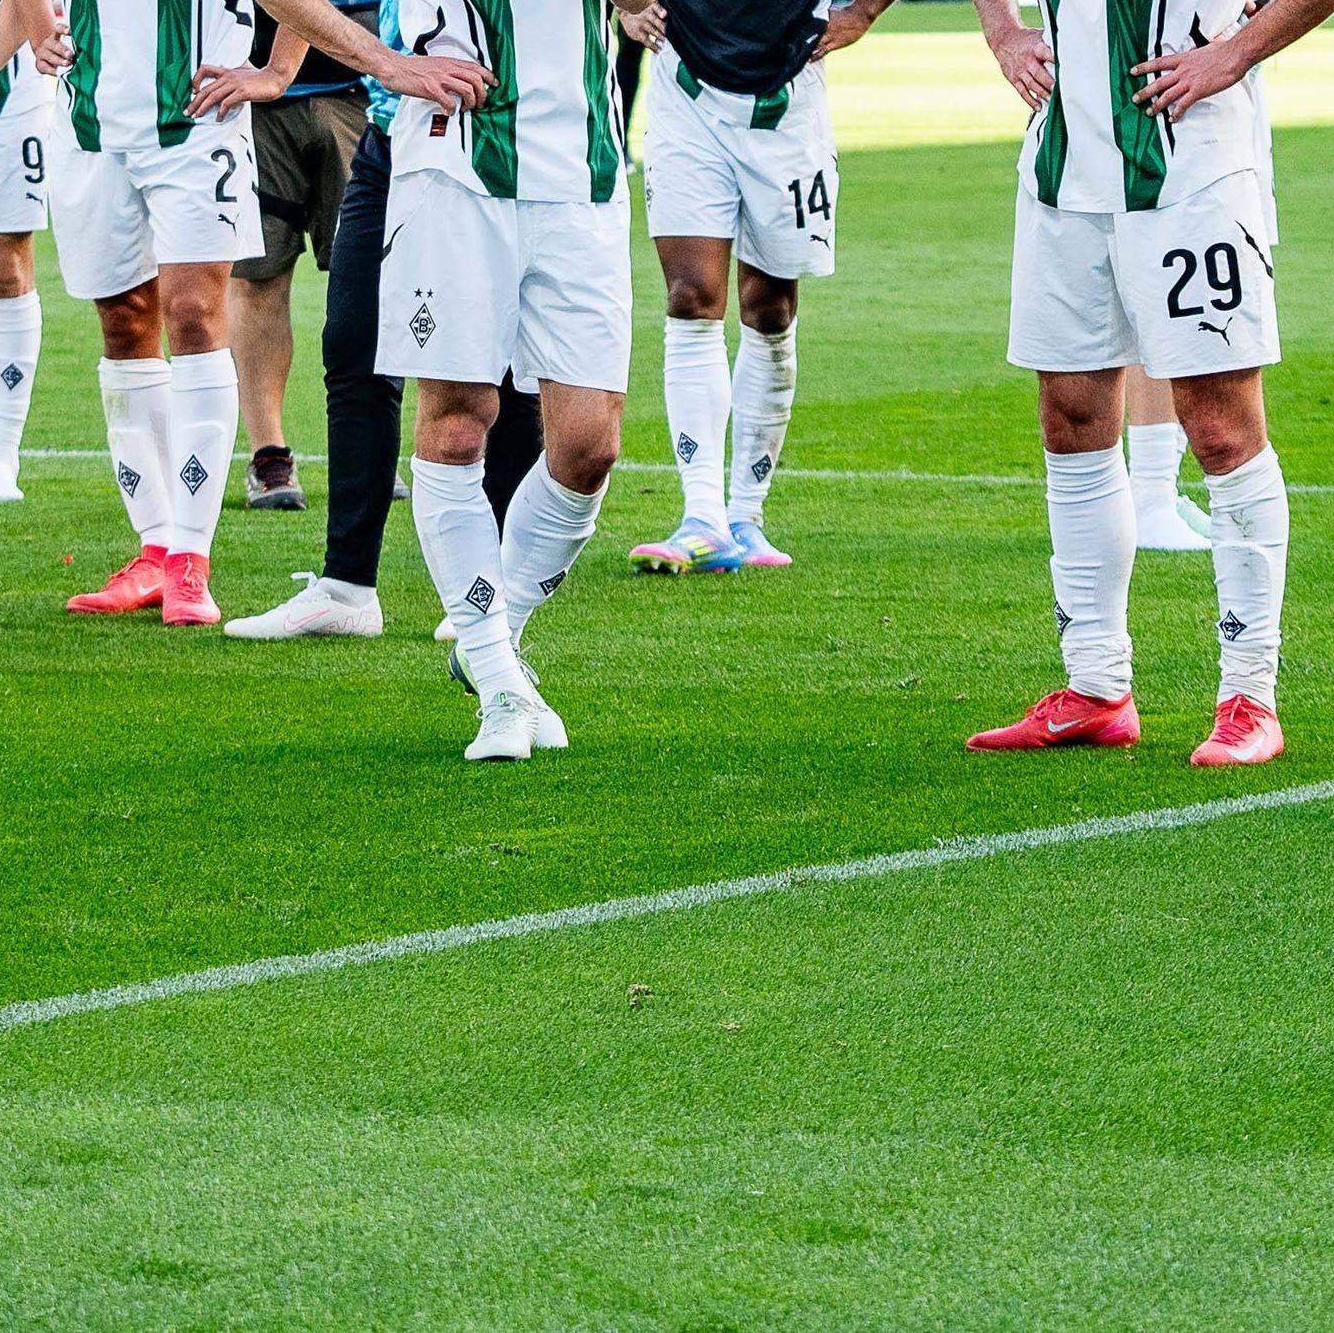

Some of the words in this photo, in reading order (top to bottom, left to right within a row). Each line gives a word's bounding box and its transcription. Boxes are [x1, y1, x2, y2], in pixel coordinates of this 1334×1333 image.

[22, 136, 45, 184] 9
[210, 150, 238, 204] 2
[787, 168, 833, 230] 14
[1161, 241, 1244, 320] 29
